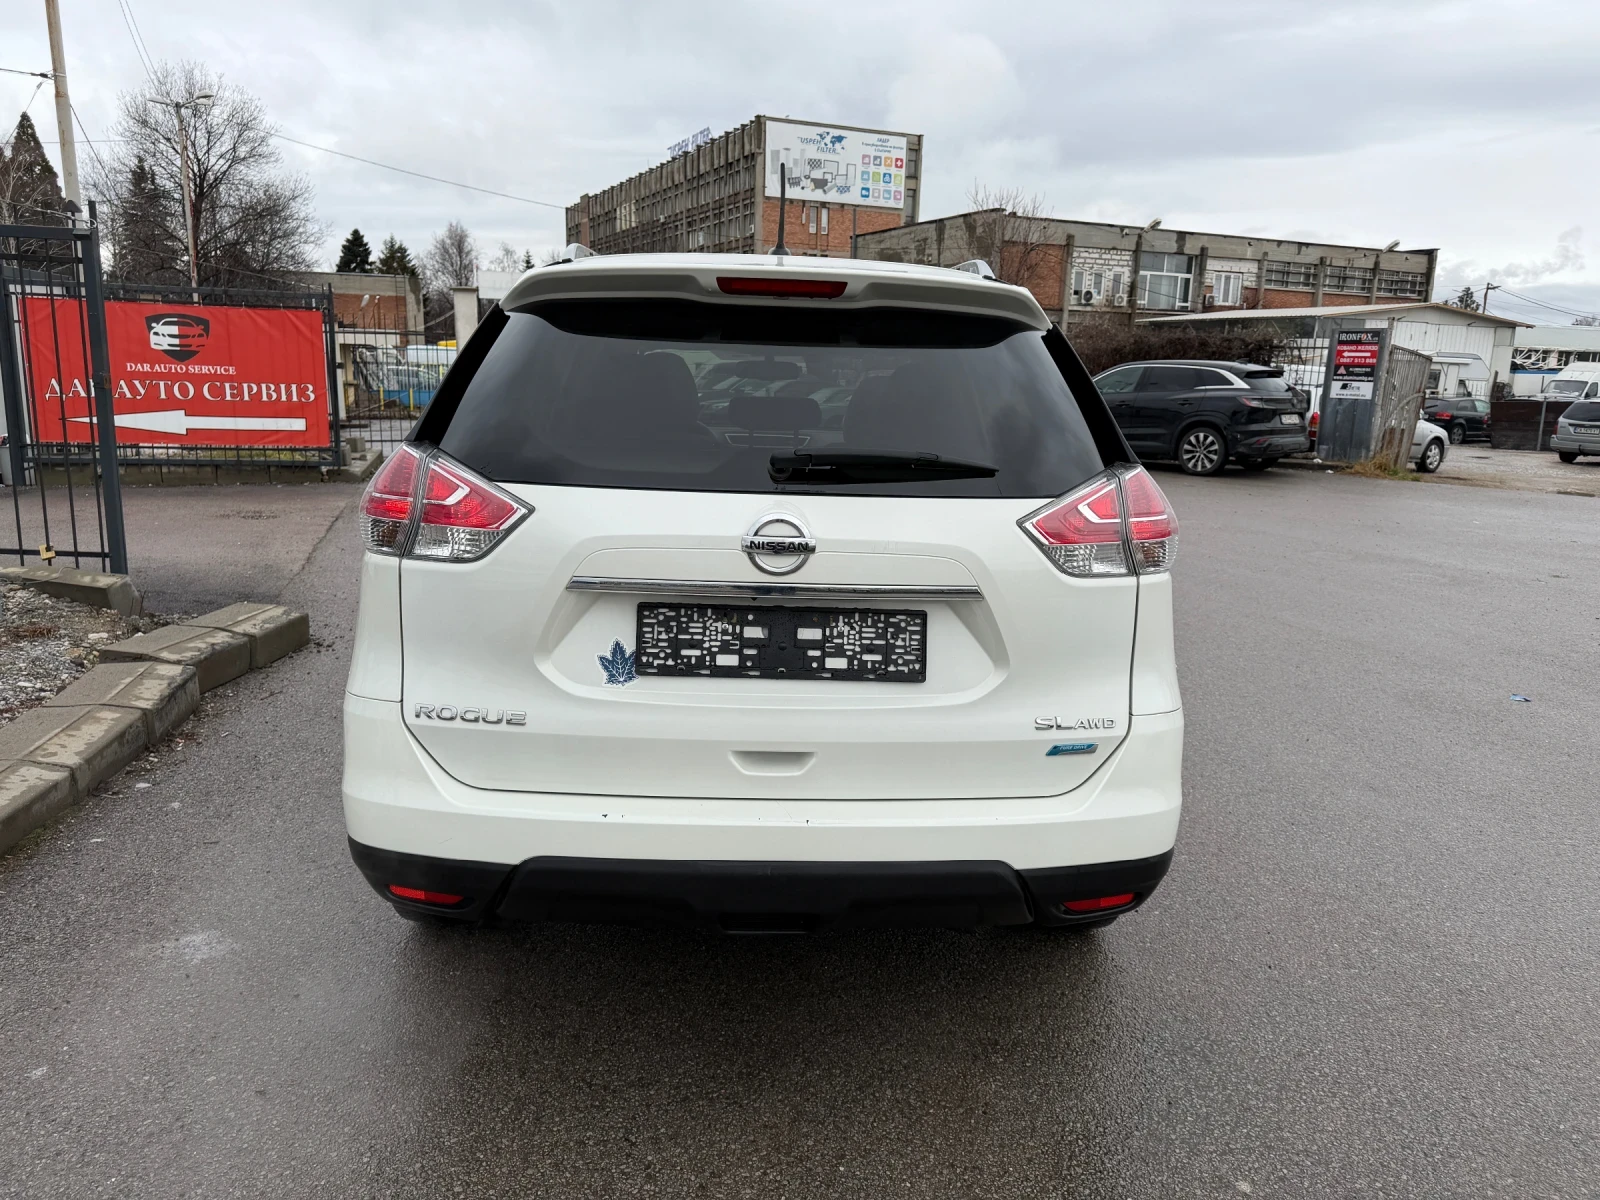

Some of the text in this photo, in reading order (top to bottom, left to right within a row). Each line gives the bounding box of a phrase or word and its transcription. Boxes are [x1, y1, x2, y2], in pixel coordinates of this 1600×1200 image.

[800, 136, 822, 145] USPEH
[816, 146, 837, 154] FILTER
[1339, 332, 1373, 341] IRONFOX
[126, 362, 237, 375] DAR AUTO SERVICE
[112, 379, 196, 401] АУТО
[202, 381, 317, 403] СЕРВИЗ
[749, 540, 809, 551] NISSAN
[414, 702, 527, 727] ROGUE
